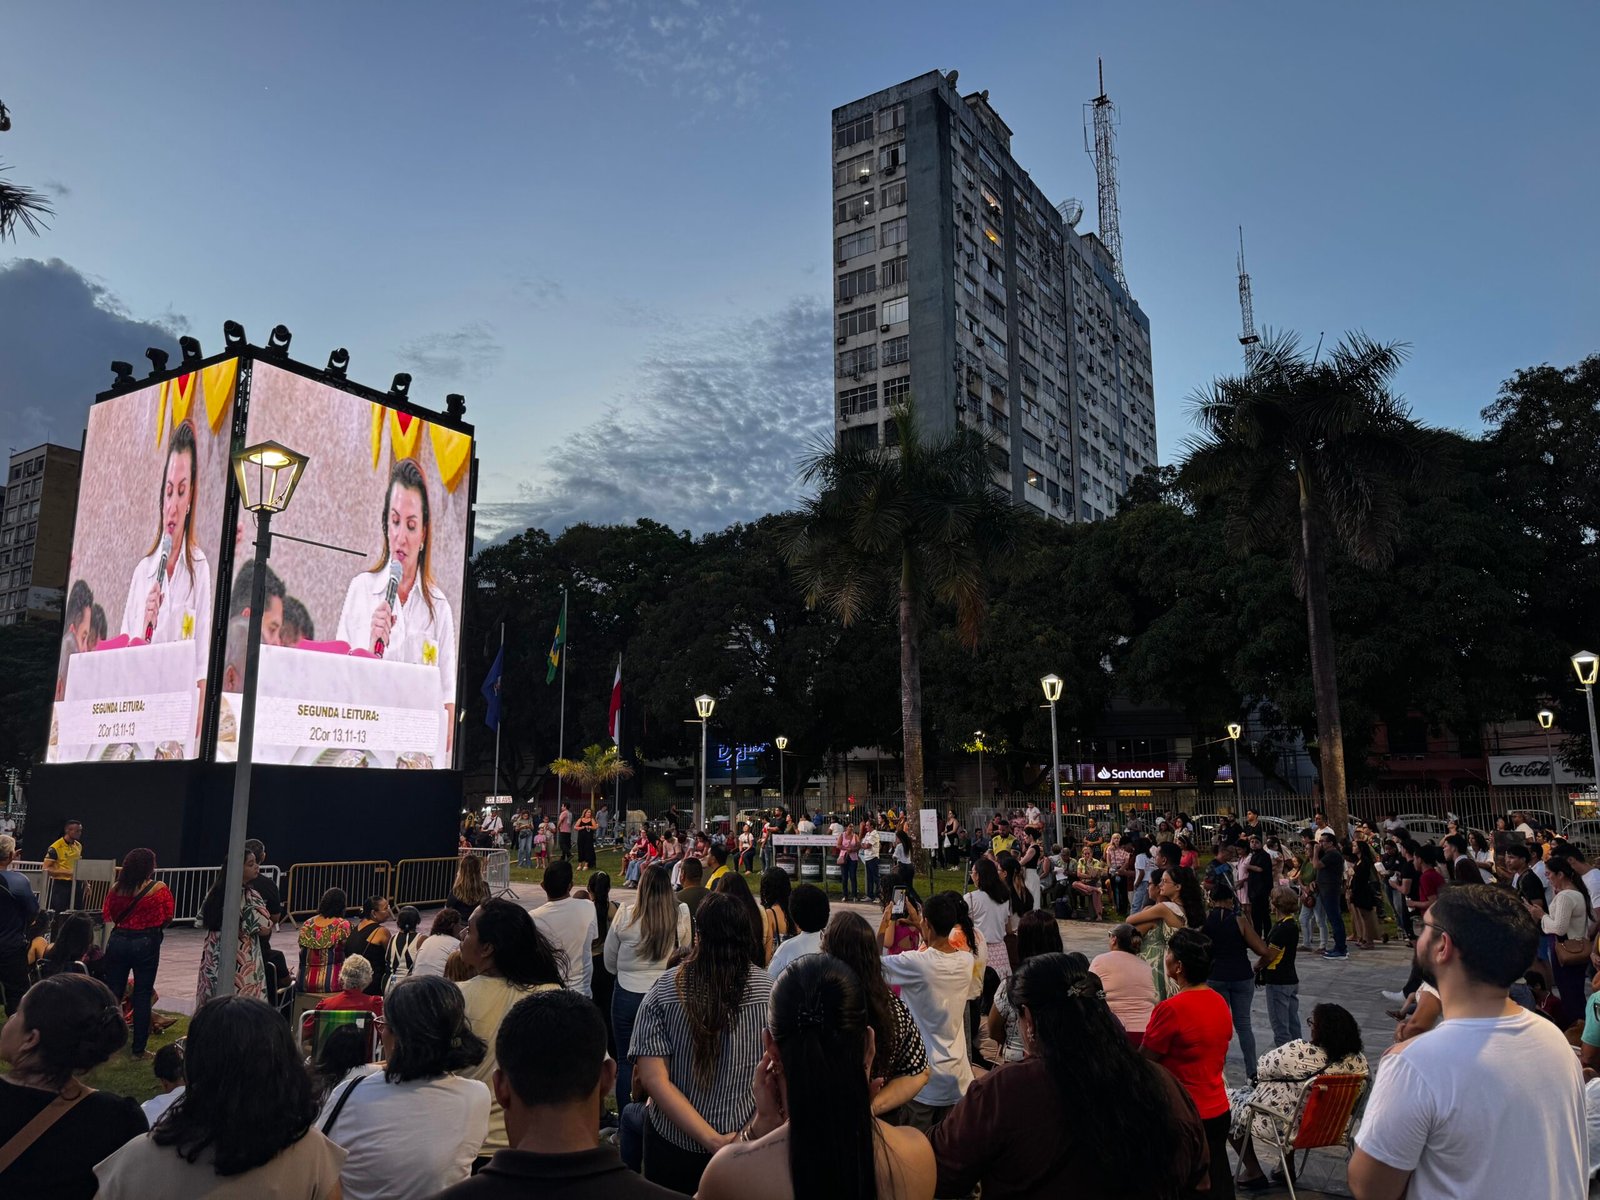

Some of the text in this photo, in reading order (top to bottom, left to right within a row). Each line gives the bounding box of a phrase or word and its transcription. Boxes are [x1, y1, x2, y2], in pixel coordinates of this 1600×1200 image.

[92, 700, 145, 714] SEGUNDA LEITURA:
[297, 705, 379, 721] SEGUNDA LEITURA:
[98, 724, 111, 737] 2Cor
[309, 727, 331, 741] 2Cor
[1111, 768, 1165, 779] Santander
[1499, 761, 1551, 777] Coca-Cola
